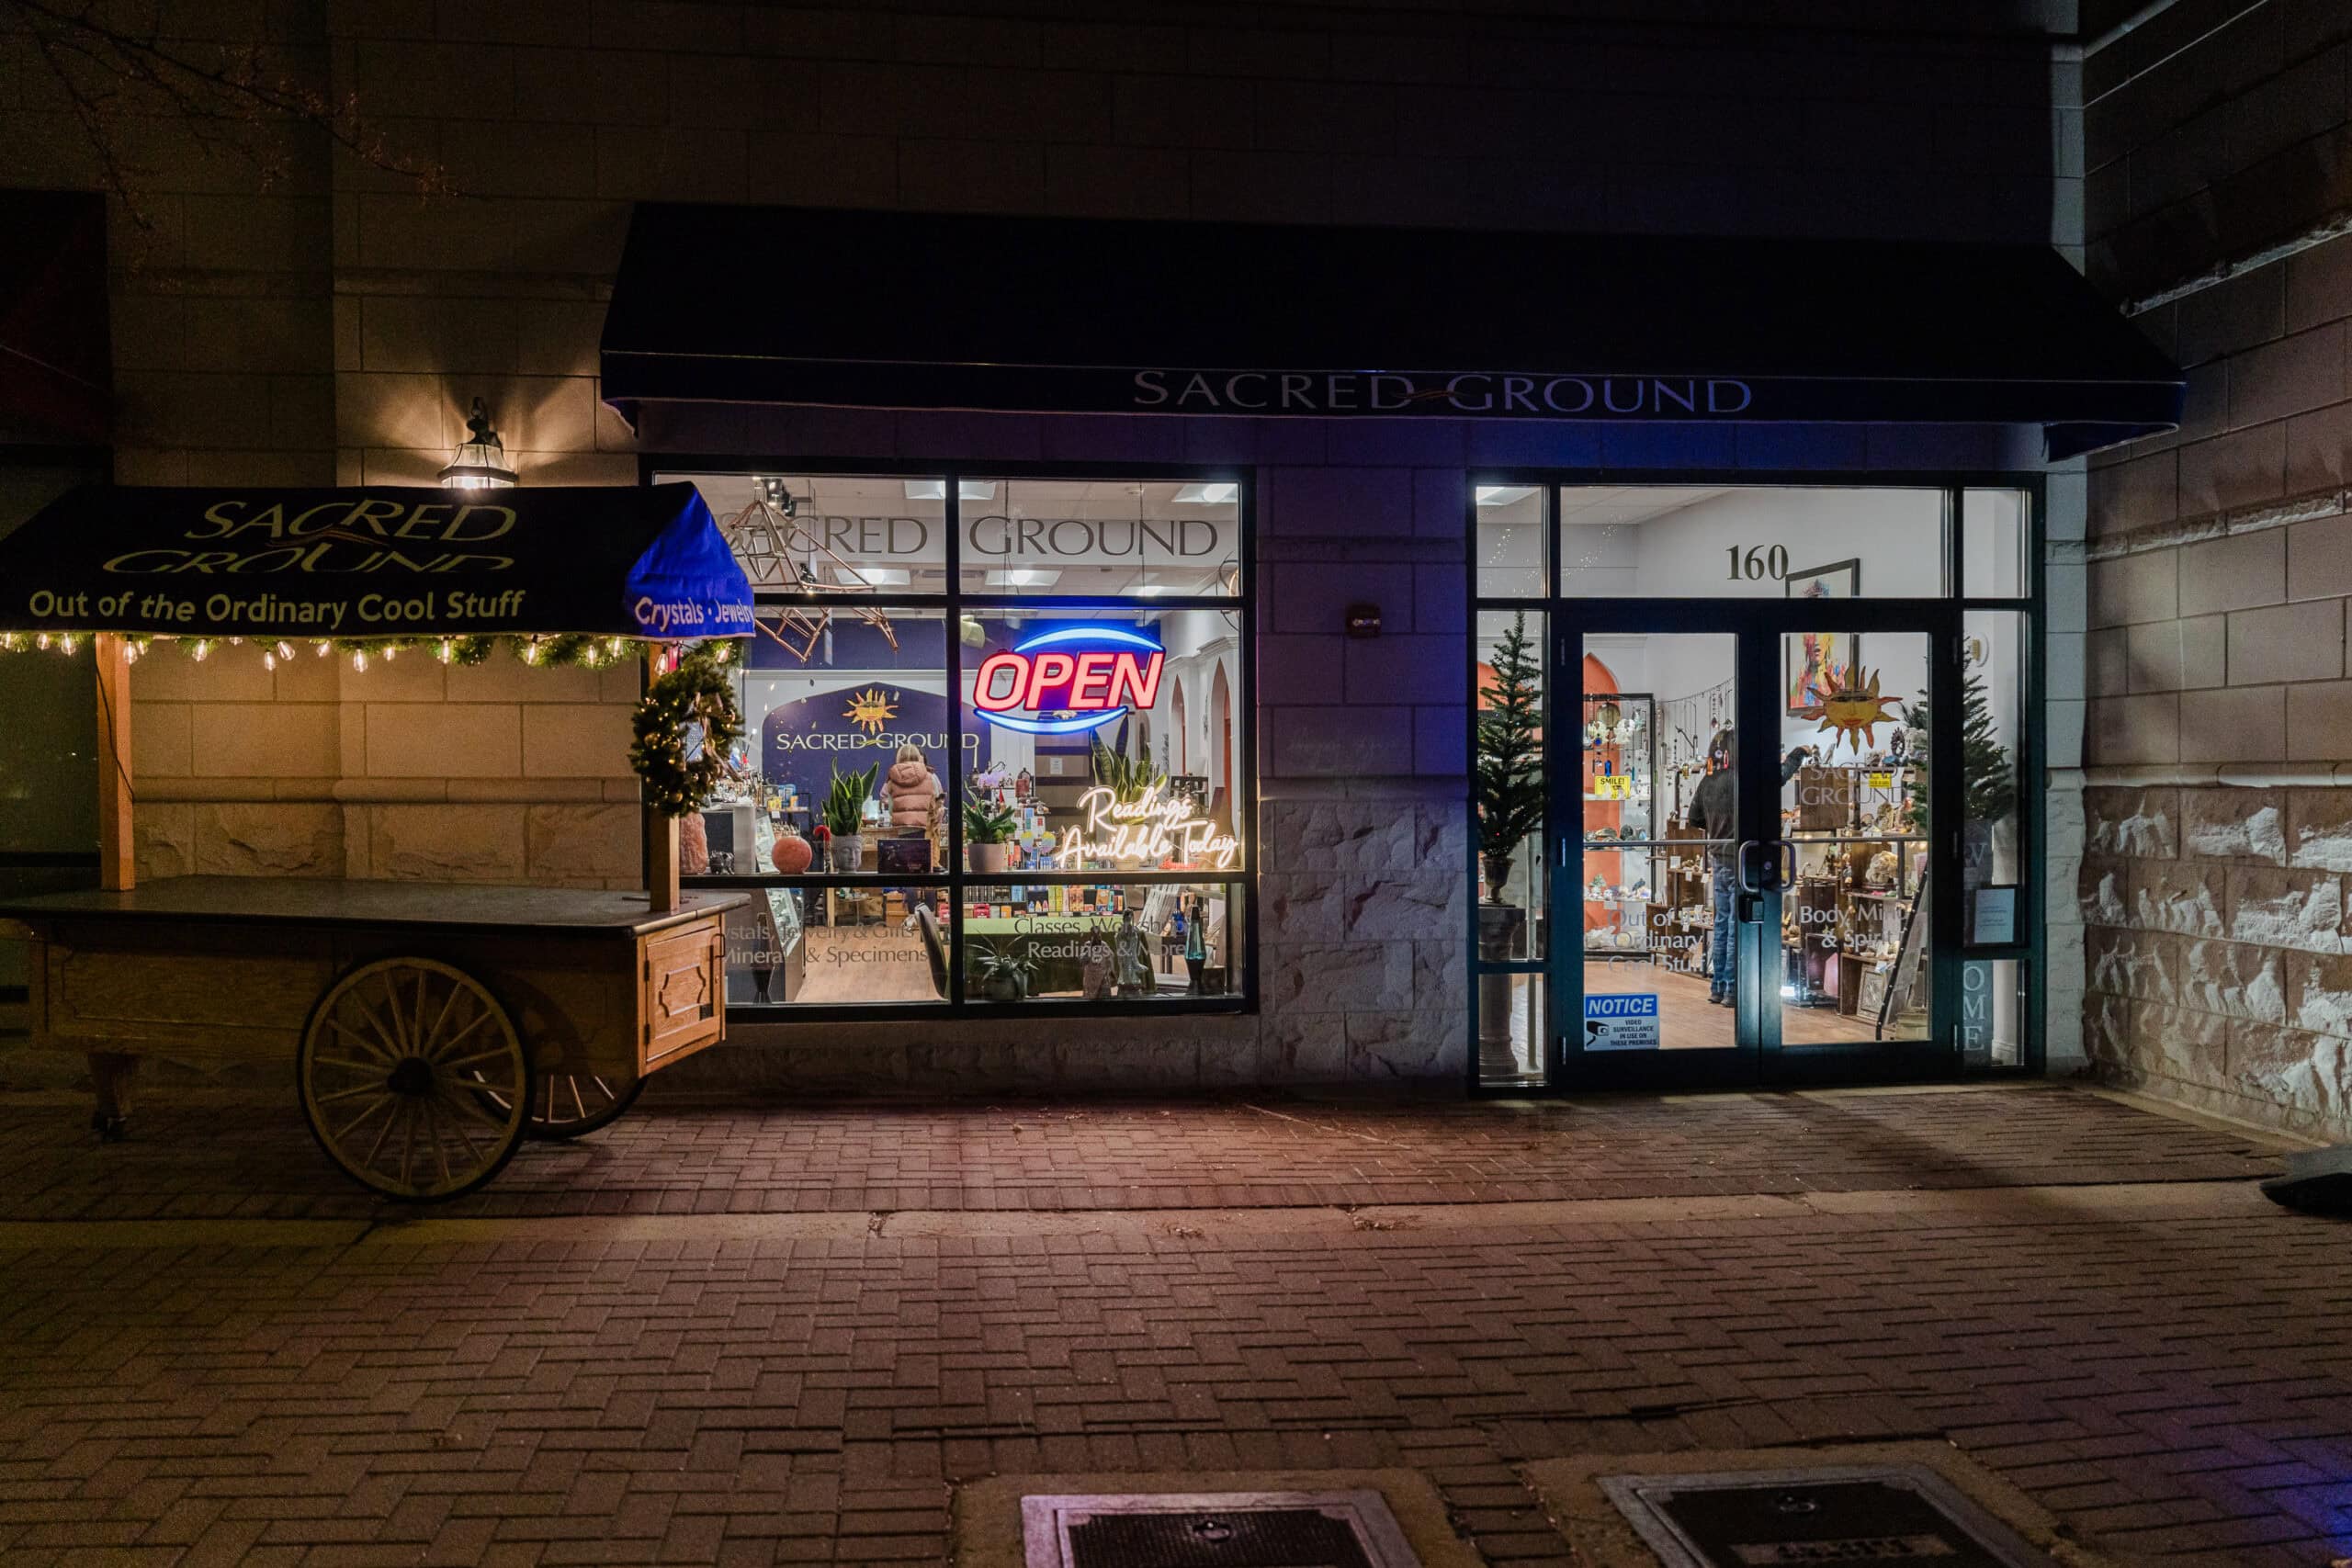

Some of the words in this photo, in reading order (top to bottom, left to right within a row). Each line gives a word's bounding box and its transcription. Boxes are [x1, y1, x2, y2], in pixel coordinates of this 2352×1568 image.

[1134, 370, 1415, 409] SACRED
[1446, 373, 1751, 412] GROUND
[185, 499, 517, 541] SACRED
[718, 512, 928, 554] SACRED
[969, 515, 1218, 556] GROUND
[102, 543, 514, 573] GROUND
[1725, 544, 1789, 581] 160
[29, 591, 89, 617] Out
[97, 591, 134, 617] of
[141, 593, 196, 622] the
[206, 593, 347, 630] Ordinary
[357, 592, 435, 621] Cool
[447, 590, 526, 618] Stuff
[634, 596, 705, 632] Crystals
[974, 651, 1165, 711] OPEN
[776, 733, 866, 751] SACRED
[875, 733, 979, 750] GROUD
[1810, 761, 1898, 781] SACRED
[1077, 784, 1193, 833] Readings
[1801, 785, 1904, 806] GROUND
[1055, 822, 1173, 870] Available
[1170, 820, 1238, 869] Today
[1607, 909, 1648, 927] Out
[1653, 908, 1675, 927] of
[806, 947, 820, 964] &
[826, 946, 928, 967] Specimens
[1028, 940, 1110, 964] Readings
[1588, 998, 1655, 1015] NOTICE
